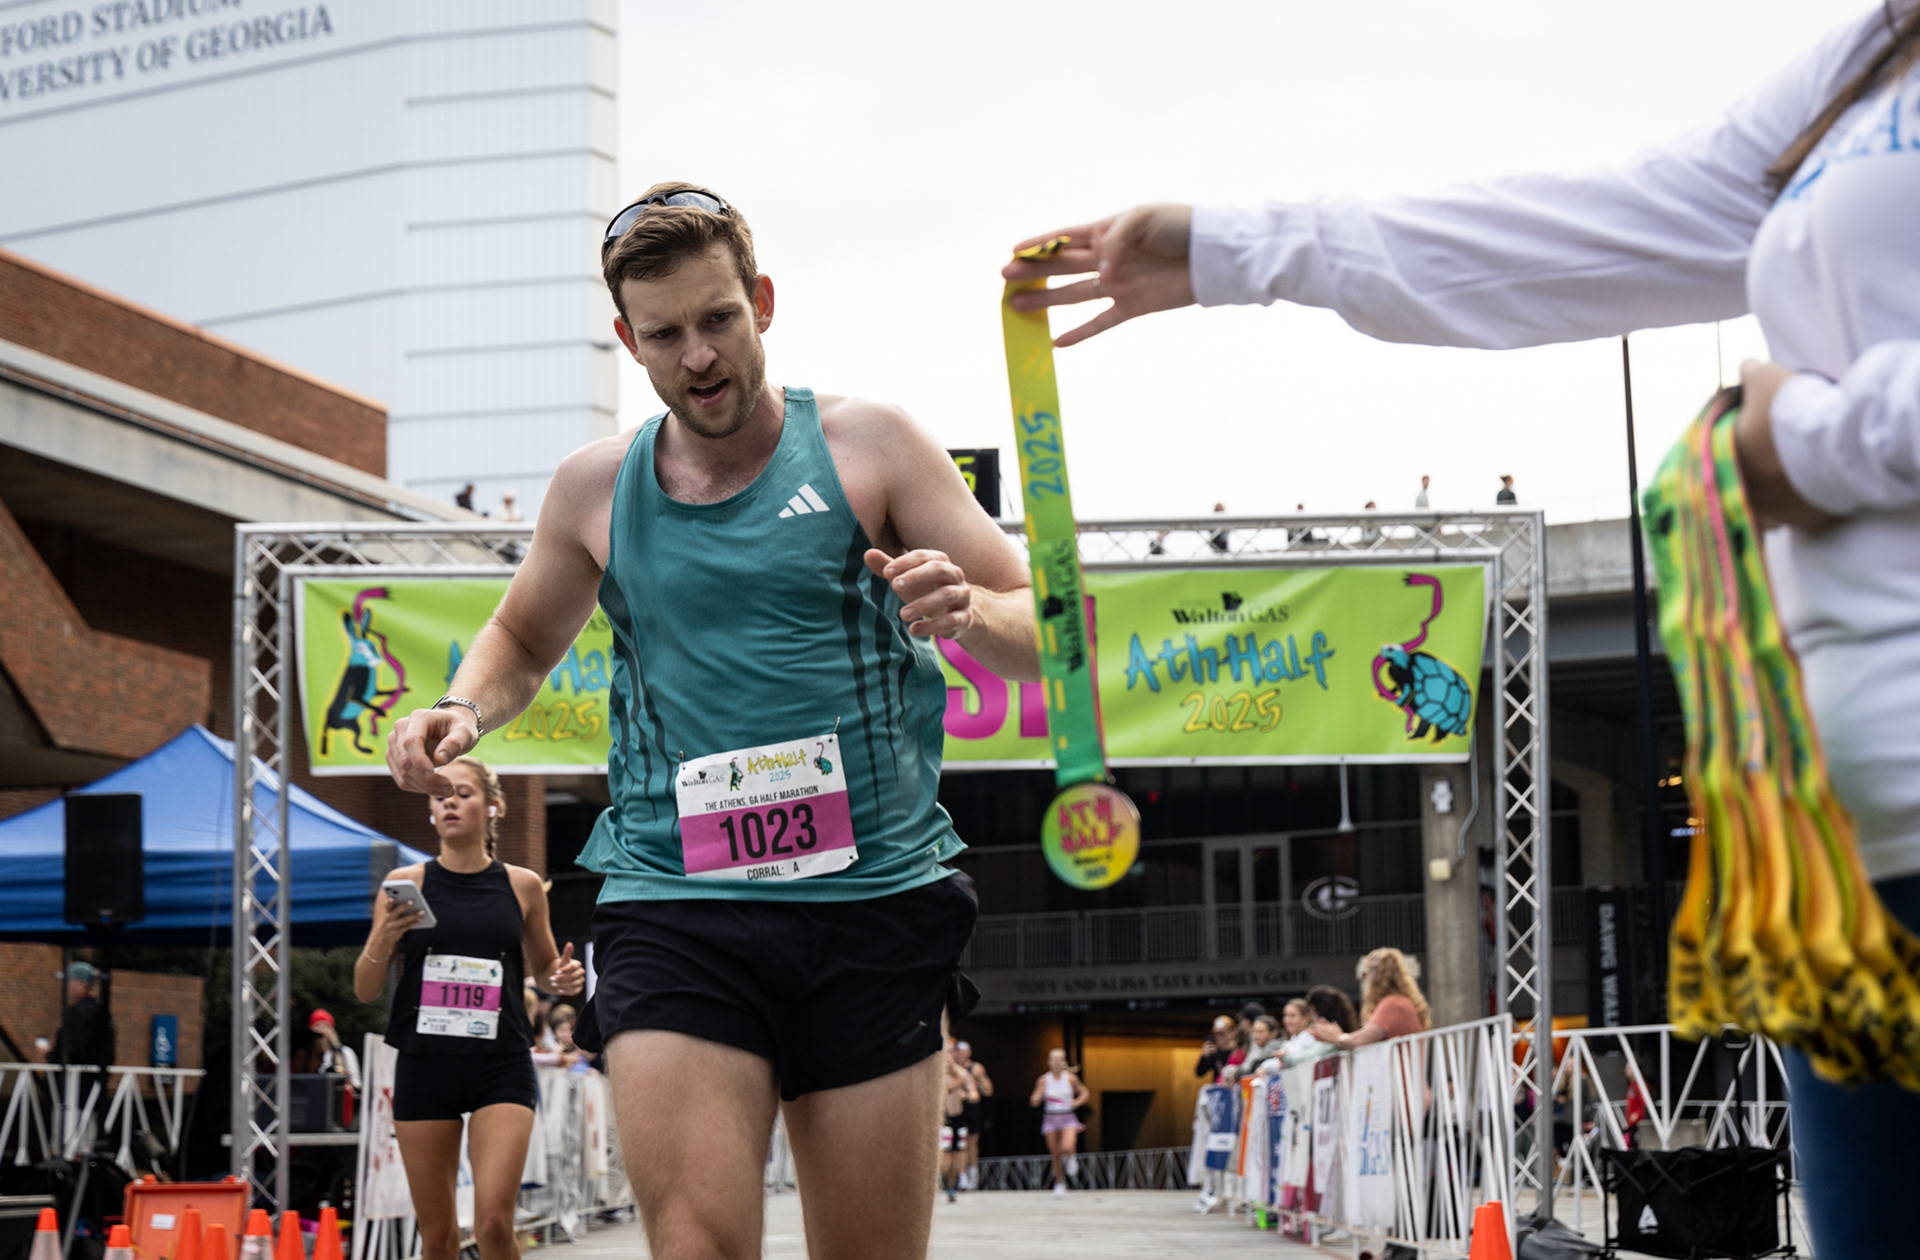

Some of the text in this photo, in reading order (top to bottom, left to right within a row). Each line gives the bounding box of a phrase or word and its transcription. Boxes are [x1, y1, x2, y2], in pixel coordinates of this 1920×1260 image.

[1, 0, 241, 57] FORD STADIU
[136, 35, 179, 76] OF
[185, 3, 332, 65] GEORGIA
[1018, 411, 1066, 500] 2025
[1248, 605, 1290, 623] GAS
[1179, 688, 1283, 734] 2025
[768, 769, 792, 783] 2025
[705, 801, 718, 812] THE
[749, 795, 759, 806] GA
[760, 791, 777, 804] HALF
[779, 784, 819, 801] MARATHON
[719, 803, 818, 862] 1023
[746, 861, 800, 880] CORRAL: A
[1263, 968, 1311, 984] GATE
[441, 984, 485, 1008] 1119
